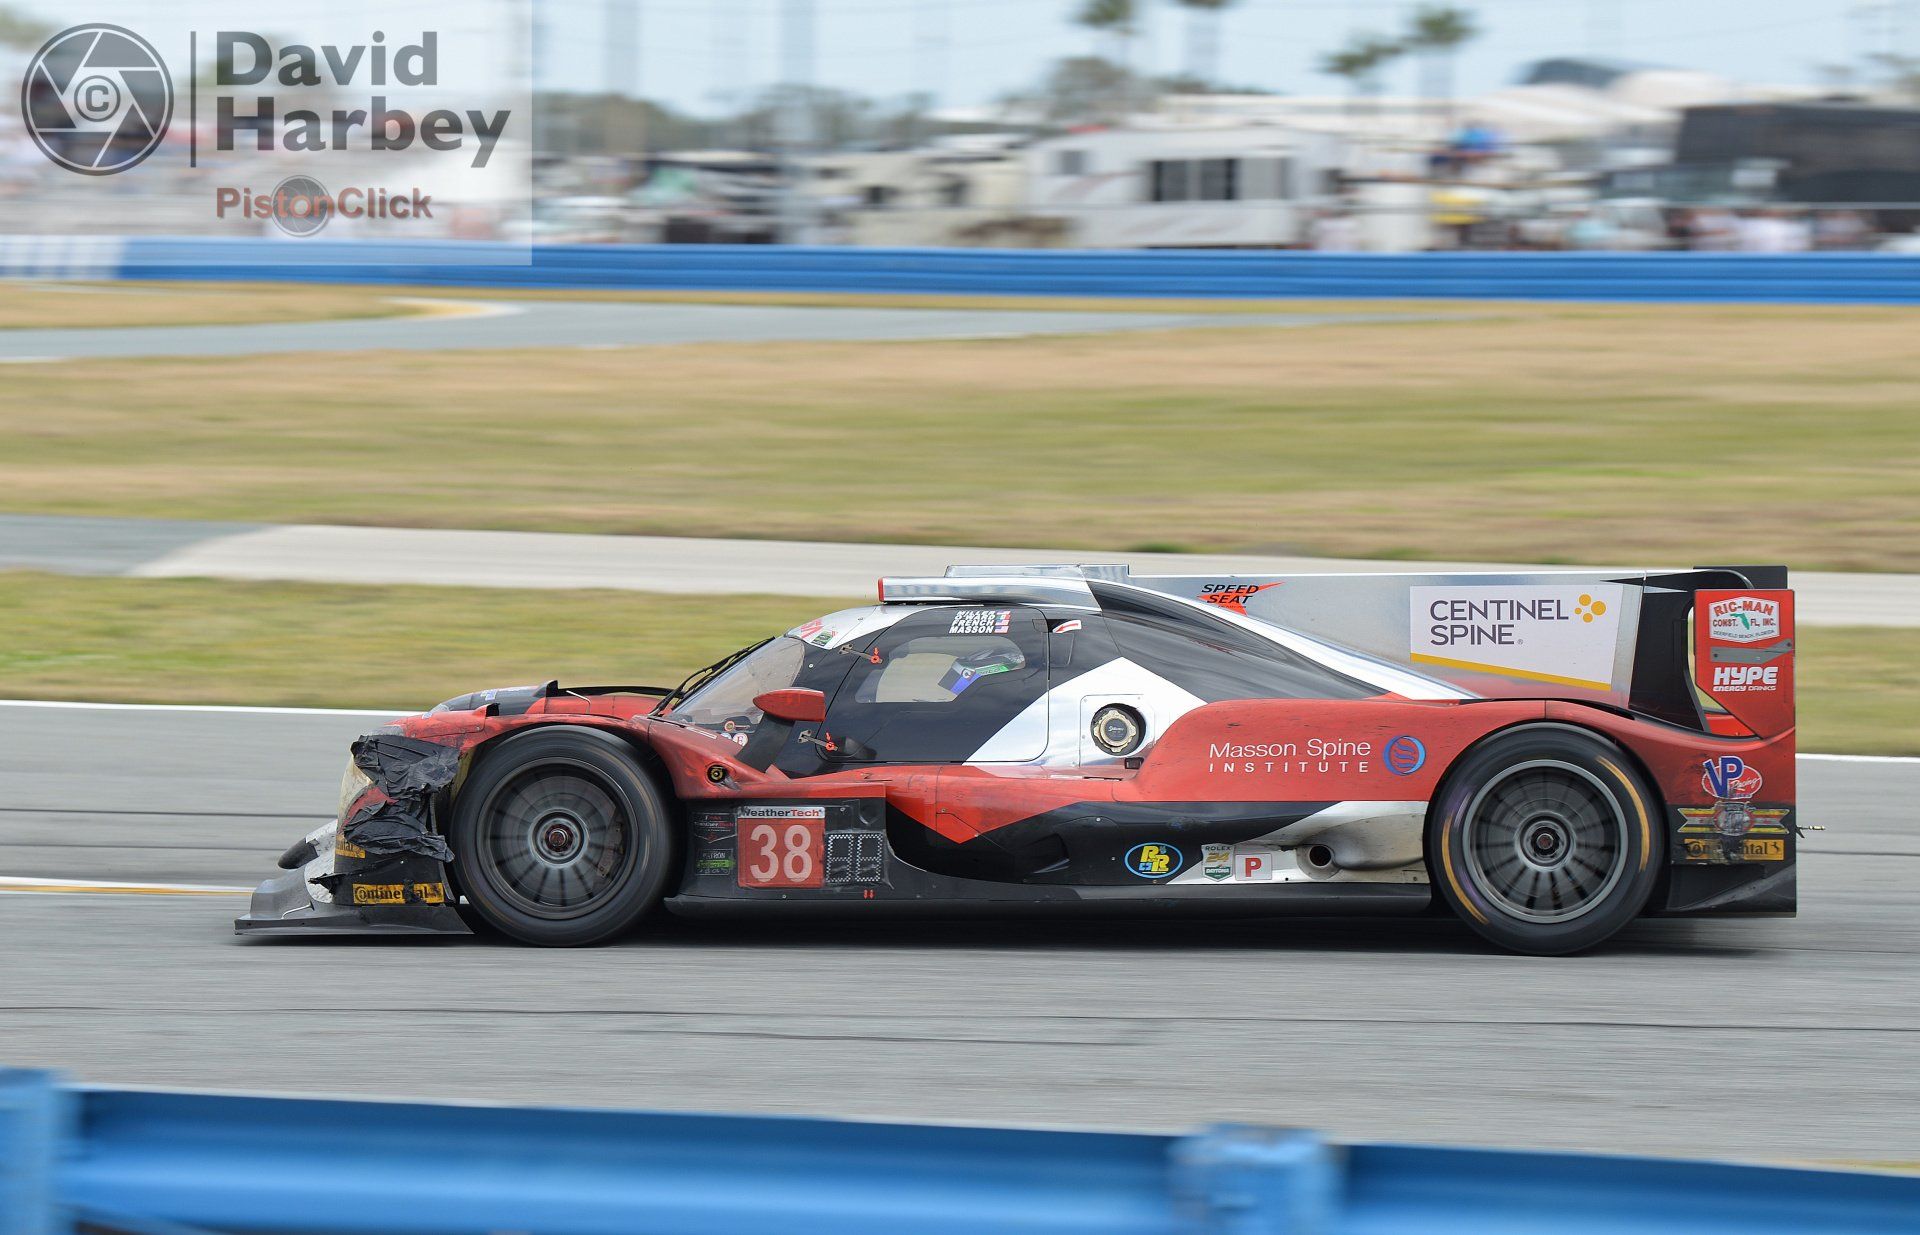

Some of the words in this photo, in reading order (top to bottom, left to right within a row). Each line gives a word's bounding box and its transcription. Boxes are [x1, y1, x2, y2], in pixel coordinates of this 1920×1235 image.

[1201, 584, 1260, 594] SPEED
[1207, 594, 1253, 604] SEAT
[1429, 599, 1569, 622] CENTINEL
[1713, 600, 1774, 617] RIC-MAN
[949, 626, 994, 634] MASSON
[1712, 618, 1739, 627] CONST.
[1713, 666, 1778, 685] HYPE
[1208, 742, 1297, 759] Masson
[1306, 738, 1372, 760] Spine
[1208, 761, 1369, 774] INSTITUTE
[1703, 756, 1744, 799] VP
[1730, 776, 1761, 792] Racing
[750, 824, 813, 883] 38
[1245, 857, 1262, 878] P
